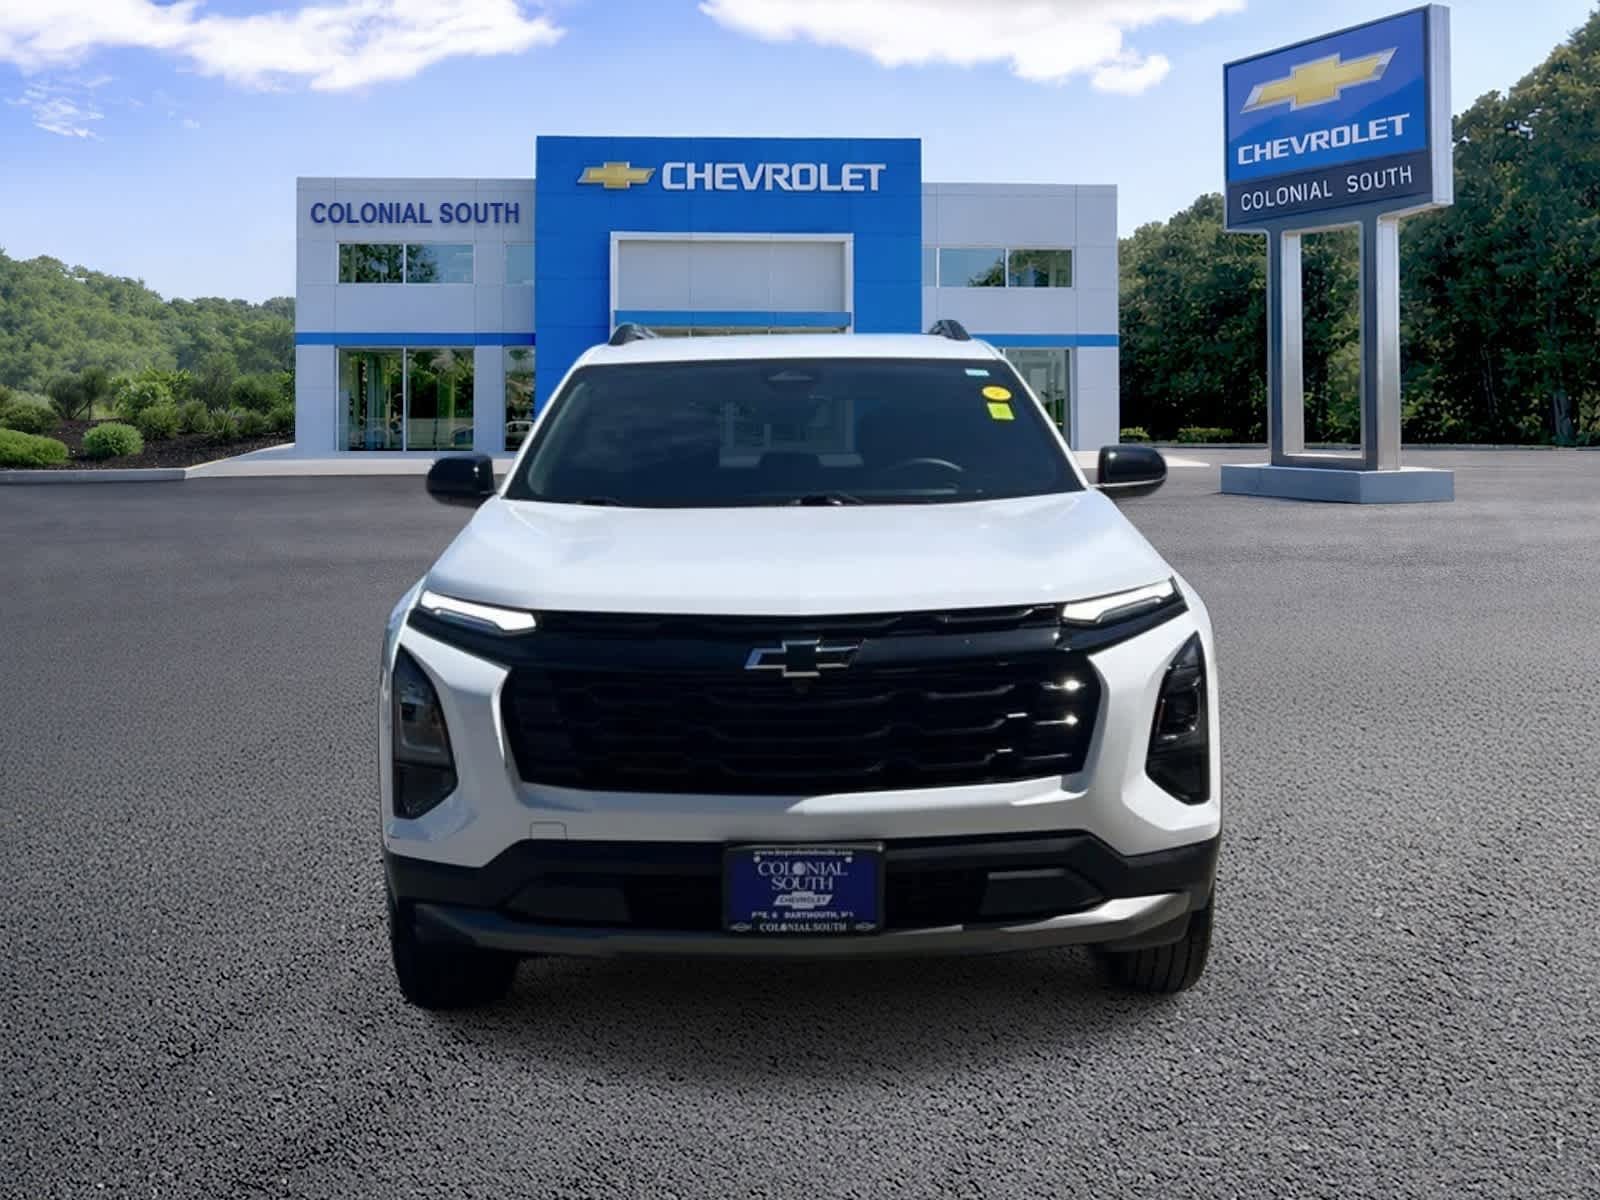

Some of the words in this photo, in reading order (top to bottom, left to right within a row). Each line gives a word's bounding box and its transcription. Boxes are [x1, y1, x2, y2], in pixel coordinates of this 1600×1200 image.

[1237, 113, 1410, 165] CHEVROLET
[662, 162, 887, 192] CHEVROLET
[1241, 181, 1333, 212] COLONIAL
[1346, 165, 1413, 194] SOUTH
[310, 202, 433, 224] COLONIAL
[438, 202, 520, 224] SOUTH
[757, 862, 849, 876] COLONIAL
[771, 876, 833, 890] SOUTH
[759, 923, 811, 932] COLONIAL
[813, 923, 847, 931] SOUTH
